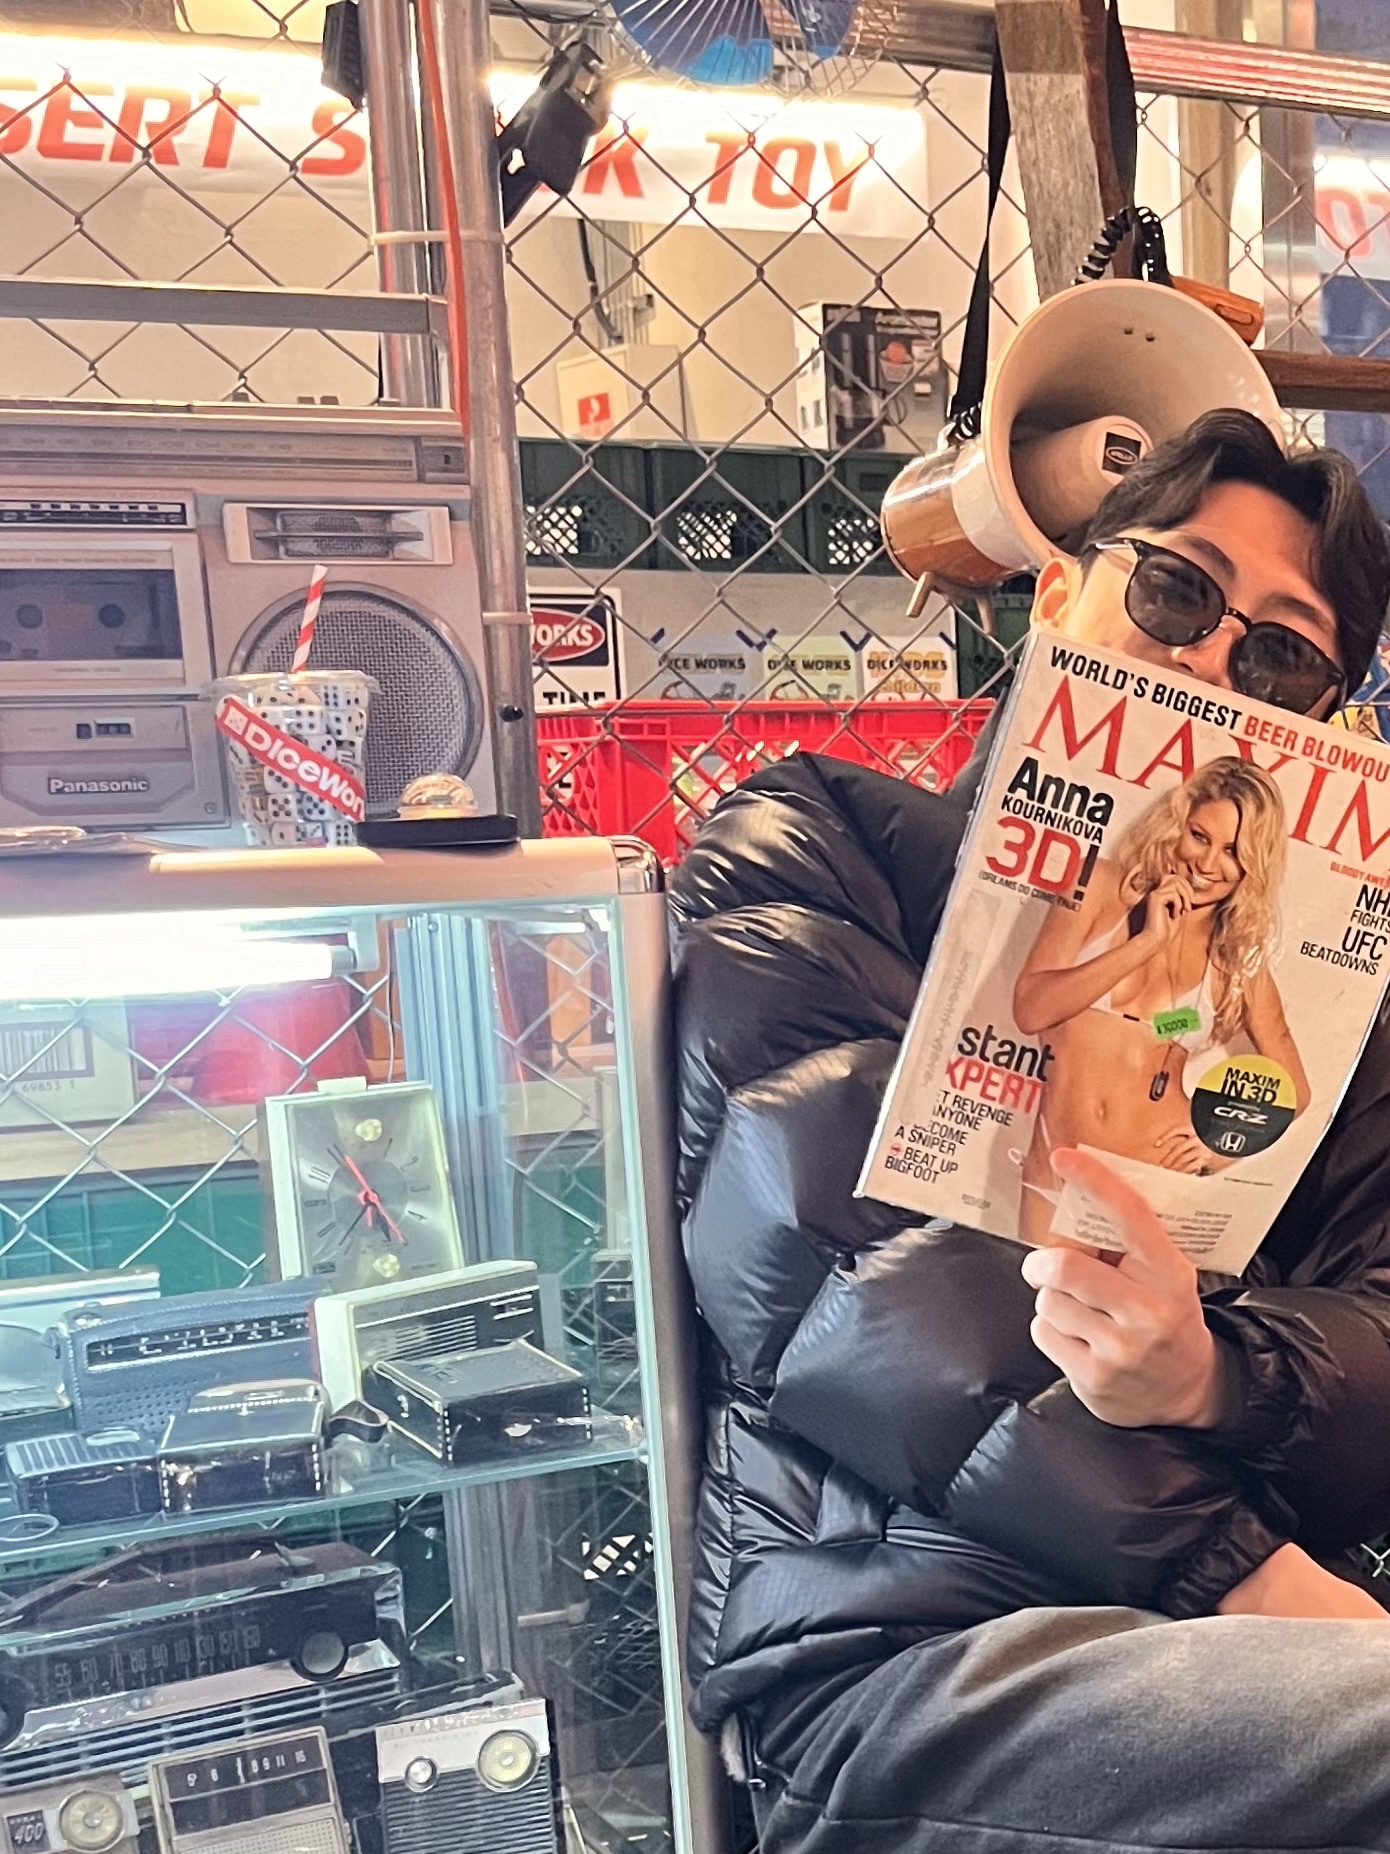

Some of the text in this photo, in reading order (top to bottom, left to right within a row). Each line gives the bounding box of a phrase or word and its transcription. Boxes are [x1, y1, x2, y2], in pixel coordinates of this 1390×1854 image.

[704, 131, 873, 212] TOY
[1051, 646, 1149, 698] WORLD'S
[1151, 683, 1242, 730] BIGGEST
[1244, 715, 1299, 751] BEER
[49, 777, 151, 794] Panasonic
[1007, 756, 1114, 827] Anna
[1001, 794, 1103, 844] KOURNIKOVA
[986, 815, 1100, 902] 3D!
[1300, 941, 1380, 976] BEATDOWNS
[1341, 926, 1388, 961] UFC
[957, 1024, 1055, 1082] stant
[21, 1081, 62, 1094] 69853
[1221, 1079, 1277, 1105] IN 3D
[1225, 1067, 1281, 1091] MAXIM
[953, 1094, 1014, 1127] REVENGE
[895, 1125, 957, 1156] A SNIPER
[884, 1155, 941, 1184] BIGFOOT
[904, 1147, 959, 1174] BEAT UP
[131, 1648, 147, 1674] 80
[152, 1644, 169, 1668] 90
[263, 1757, 271, 1770] 9
[14, 1822, 44, 1844] 400
